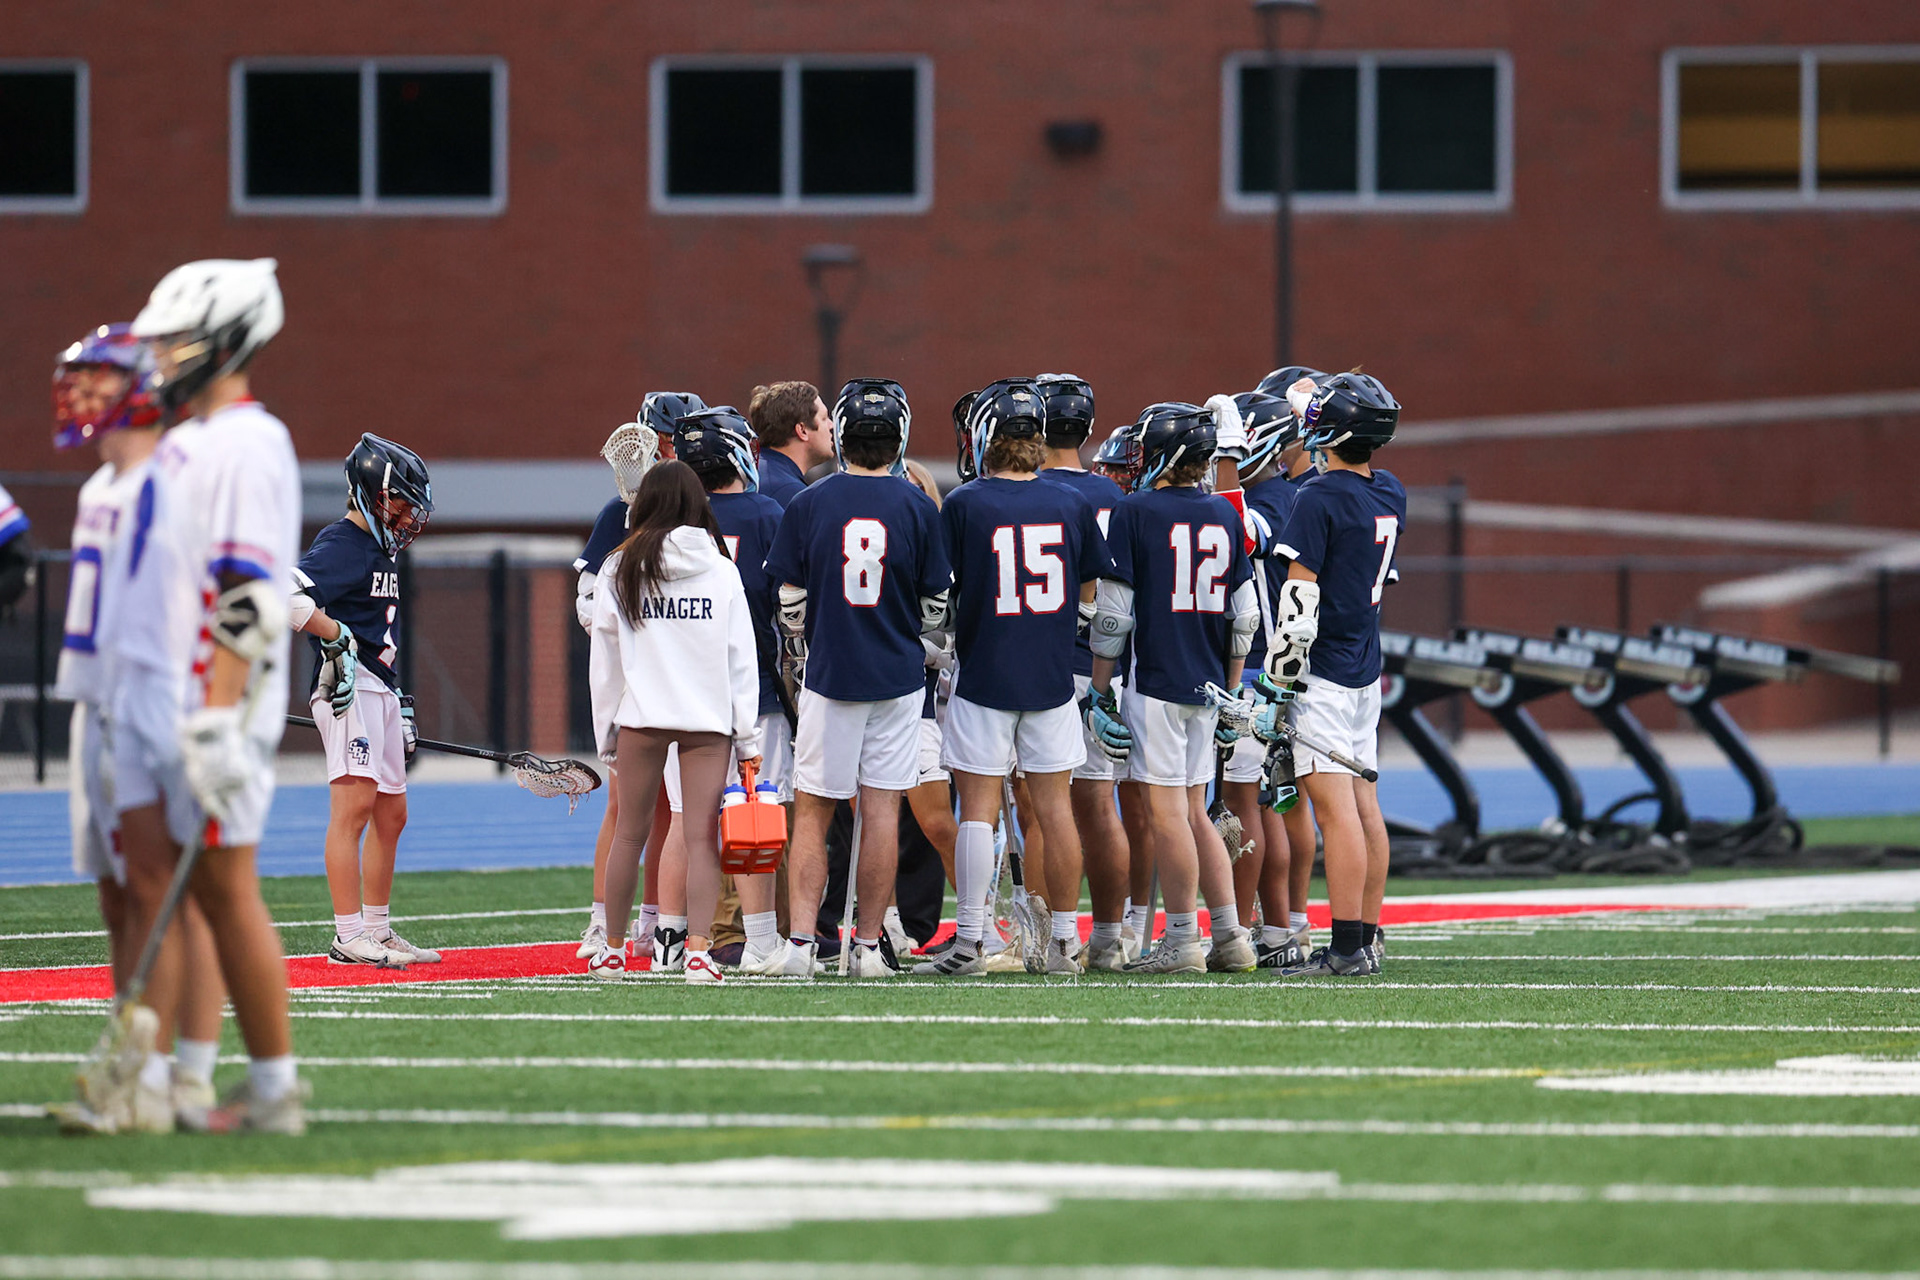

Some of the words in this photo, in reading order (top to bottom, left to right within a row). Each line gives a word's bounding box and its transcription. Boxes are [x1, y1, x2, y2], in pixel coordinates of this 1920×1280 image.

[370, 571, 400, 600] EAG
[842, 517, 888, 608] 8
[991, 523, 1066, 617] 15
[1169, 522, 1231, 614] 12
[1370, 514, 1399, 606] 7
[641, 596, 713, 620] ANAGER
[348, 740, 370, 766] SBA
